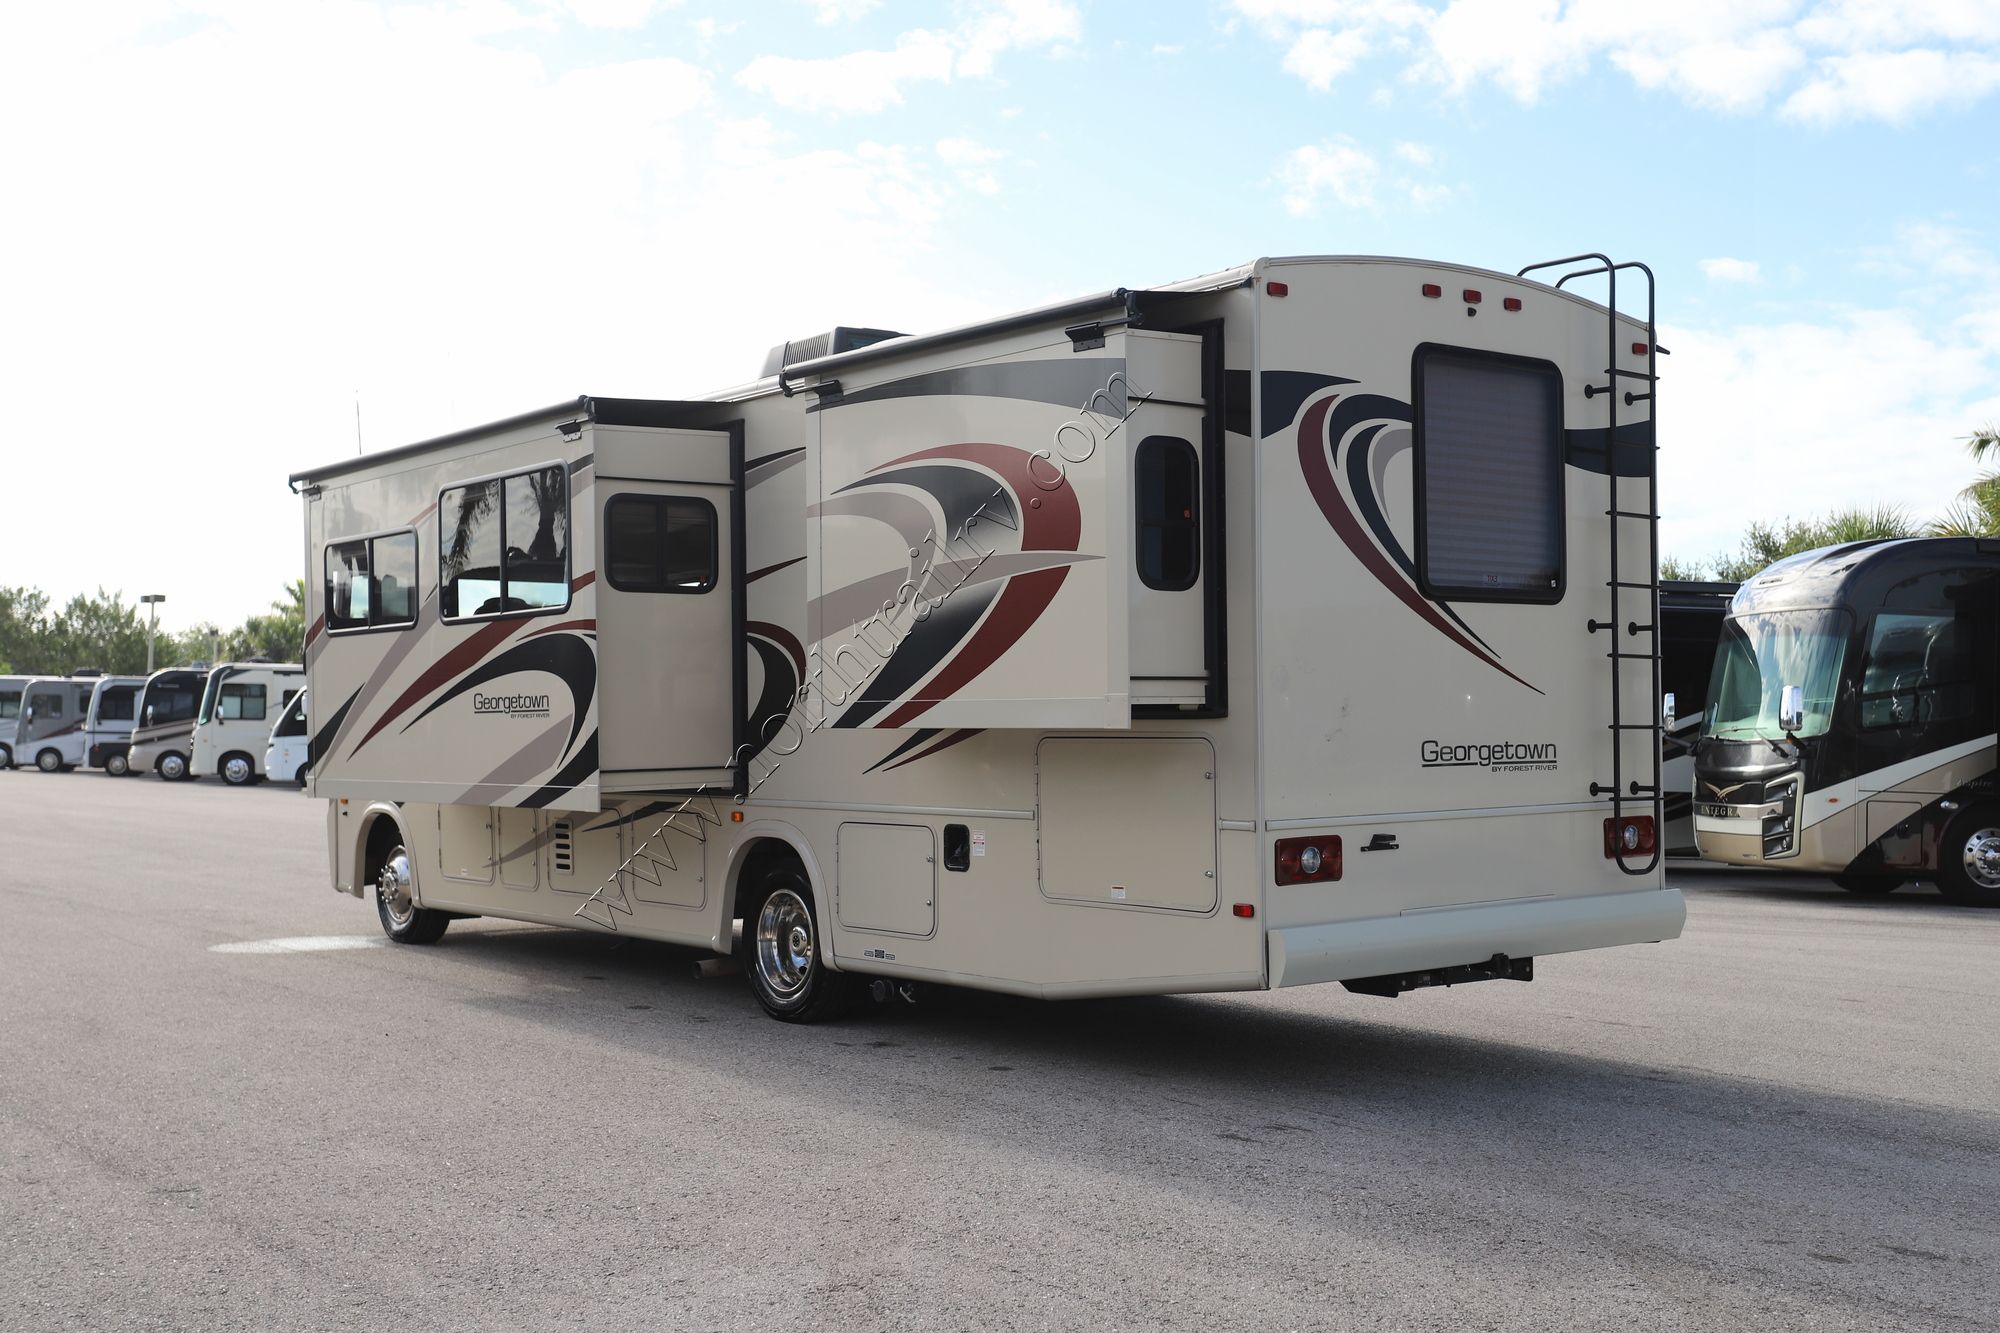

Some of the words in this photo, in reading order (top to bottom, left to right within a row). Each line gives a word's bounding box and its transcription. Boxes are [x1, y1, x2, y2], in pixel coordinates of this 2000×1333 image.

[473, 693, 550, 714] Georgetown
[1421, 740, 1557, 767] Georgetown
[1491, 765, 1502, 773] BY
[1700, 805, 1742, 818] ENTEGRA
